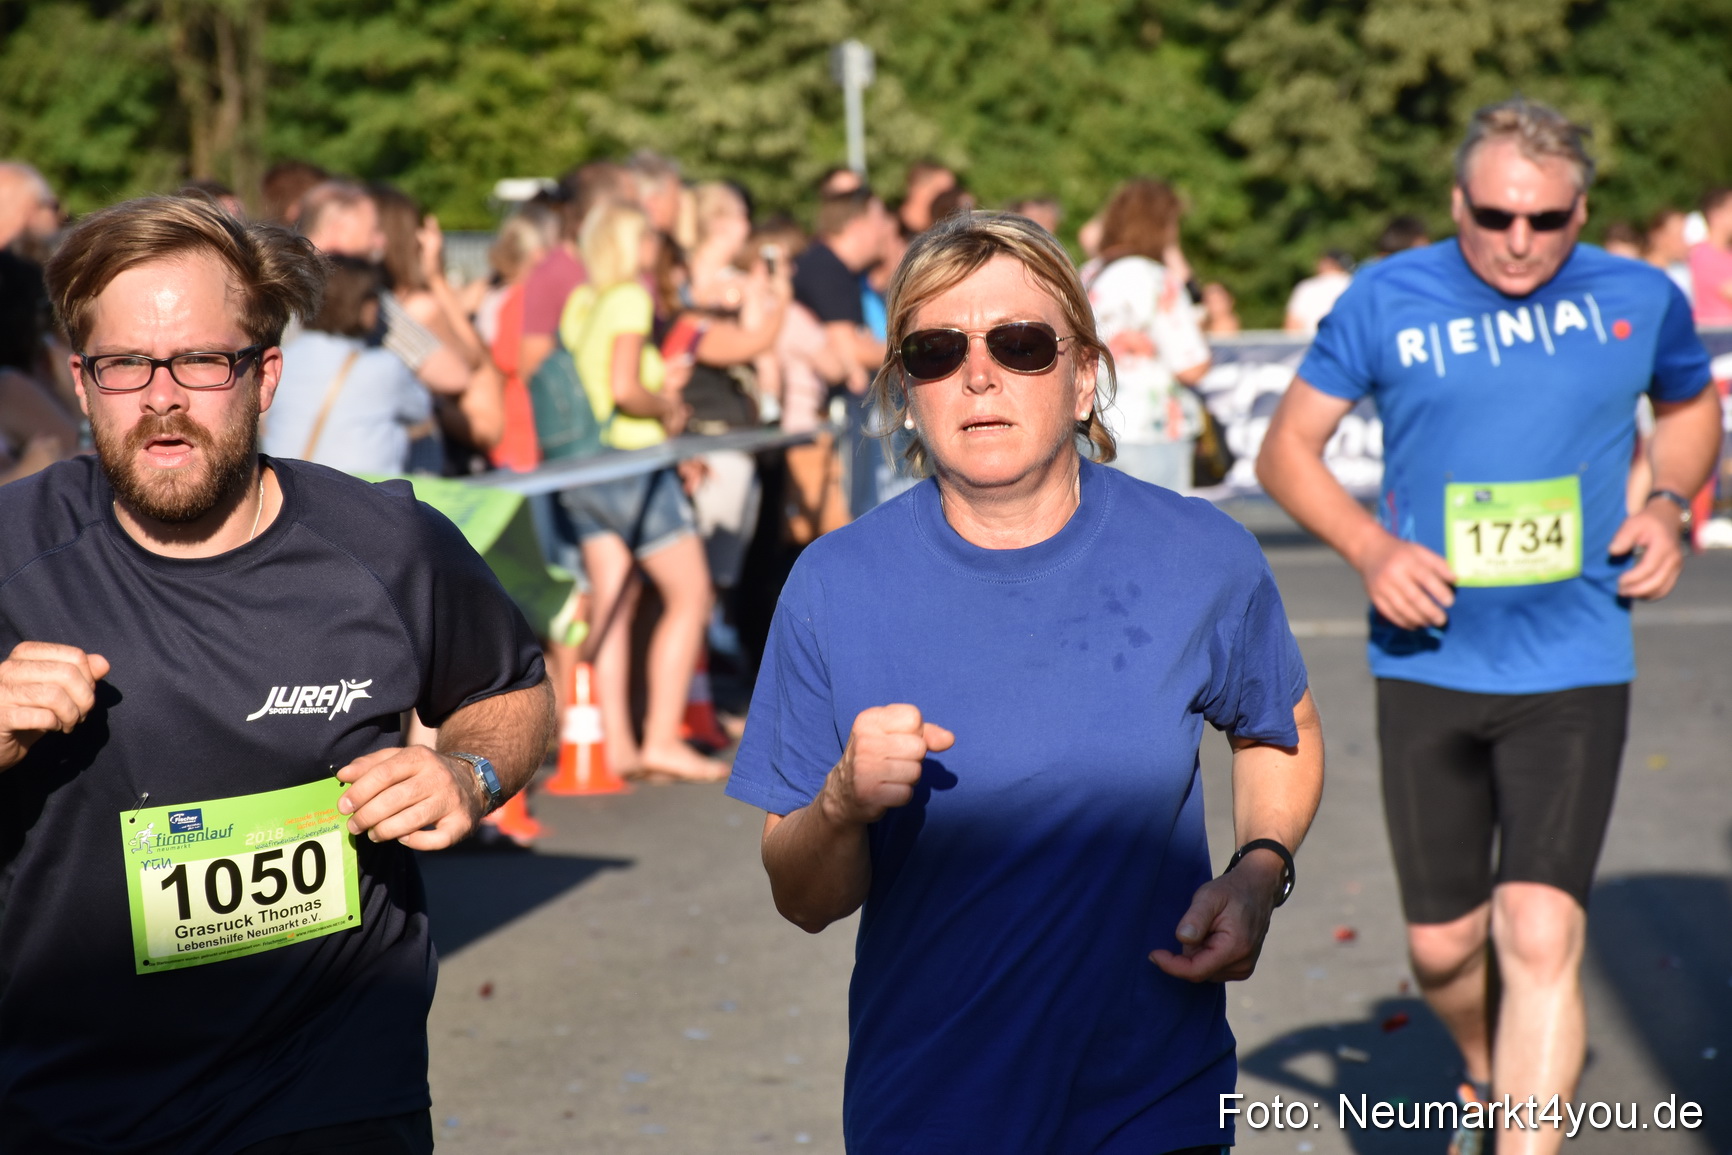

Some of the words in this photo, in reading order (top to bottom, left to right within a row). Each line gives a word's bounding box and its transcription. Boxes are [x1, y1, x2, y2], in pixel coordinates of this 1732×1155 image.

[1467, 516, 1564, 555] 1734
[246, 685, 340, 721] JURA
[300, 706, 328, 714] SERVICE
[156, 823, 234, 847] firmenlauf
[157, 843, 191, 853] neumarkt
[245, 827, 284, 846] 2018
[161, 839, 327, 921] 1050
[175, 914, 254, 939] Grasruck
[258, 897, 322, 923] Thomas
[177, 933, 244, 952] Lebenshilfe
[247, 919, 299, 939] Neumarkt
[302, 913, 321, 925] e.V.
